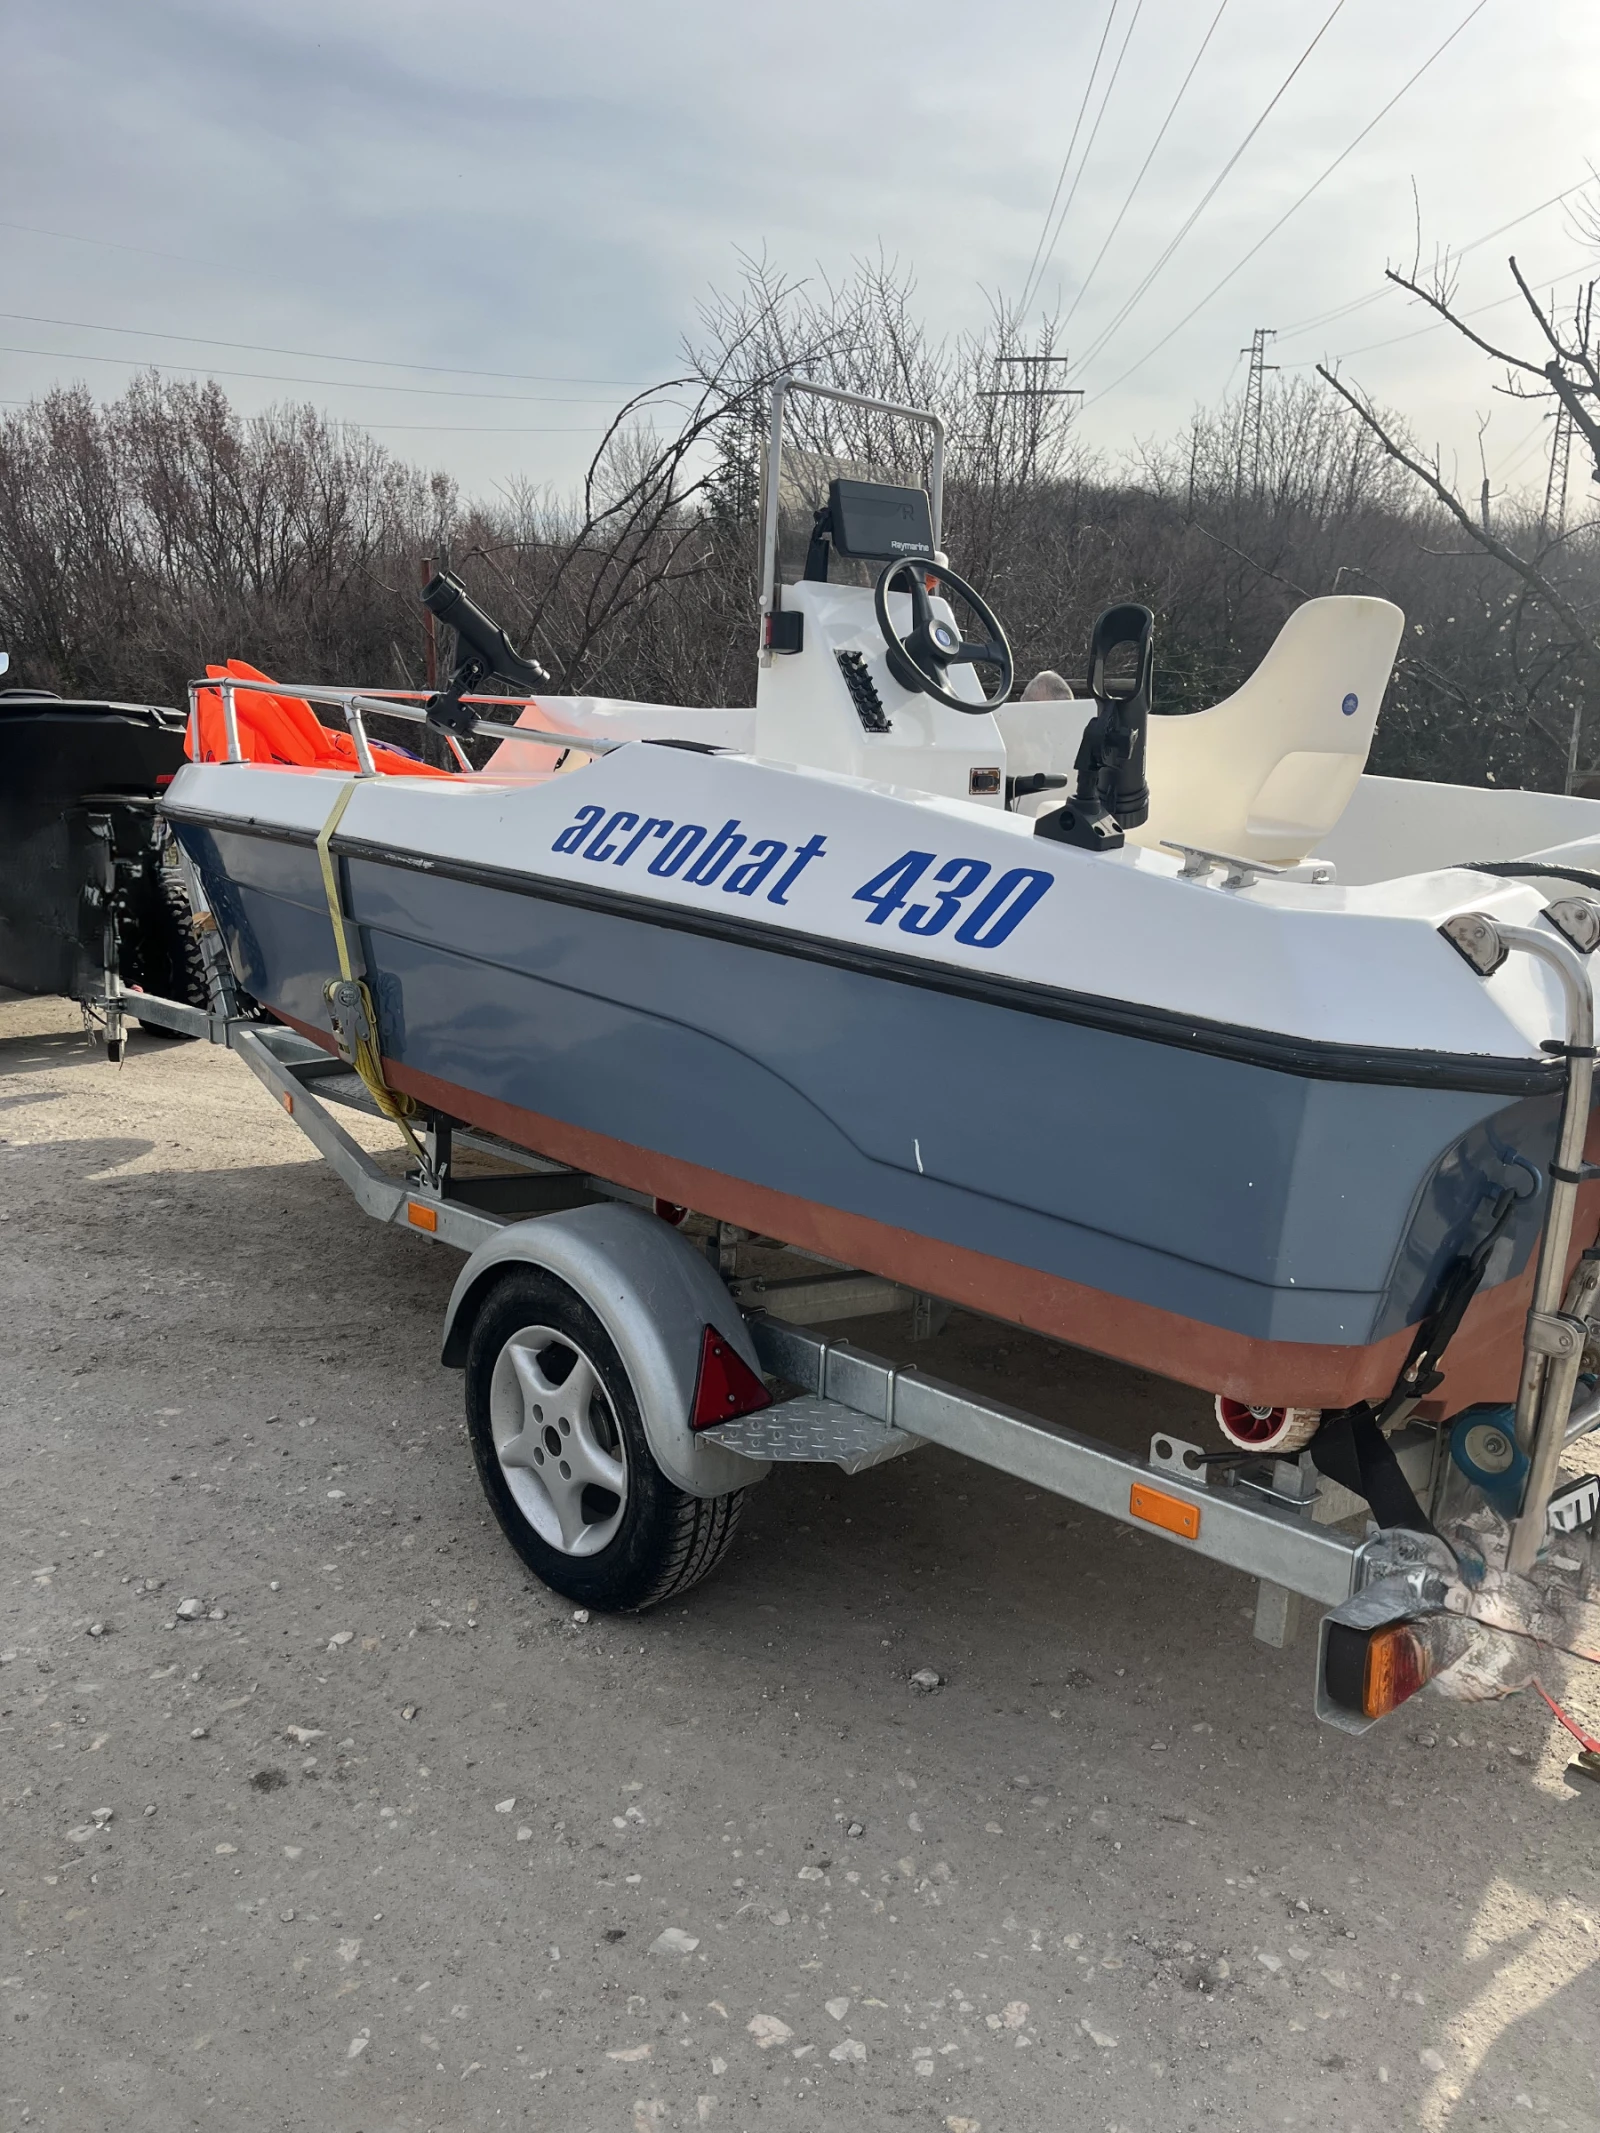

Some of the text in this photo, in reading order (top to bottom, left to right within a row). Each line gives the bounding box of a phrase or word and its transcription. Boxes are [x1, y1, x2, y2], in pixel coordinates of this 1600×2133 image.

[891, 540, 930, 552] Raymarine
[552, 805, 1055, 949] acrobat 430
